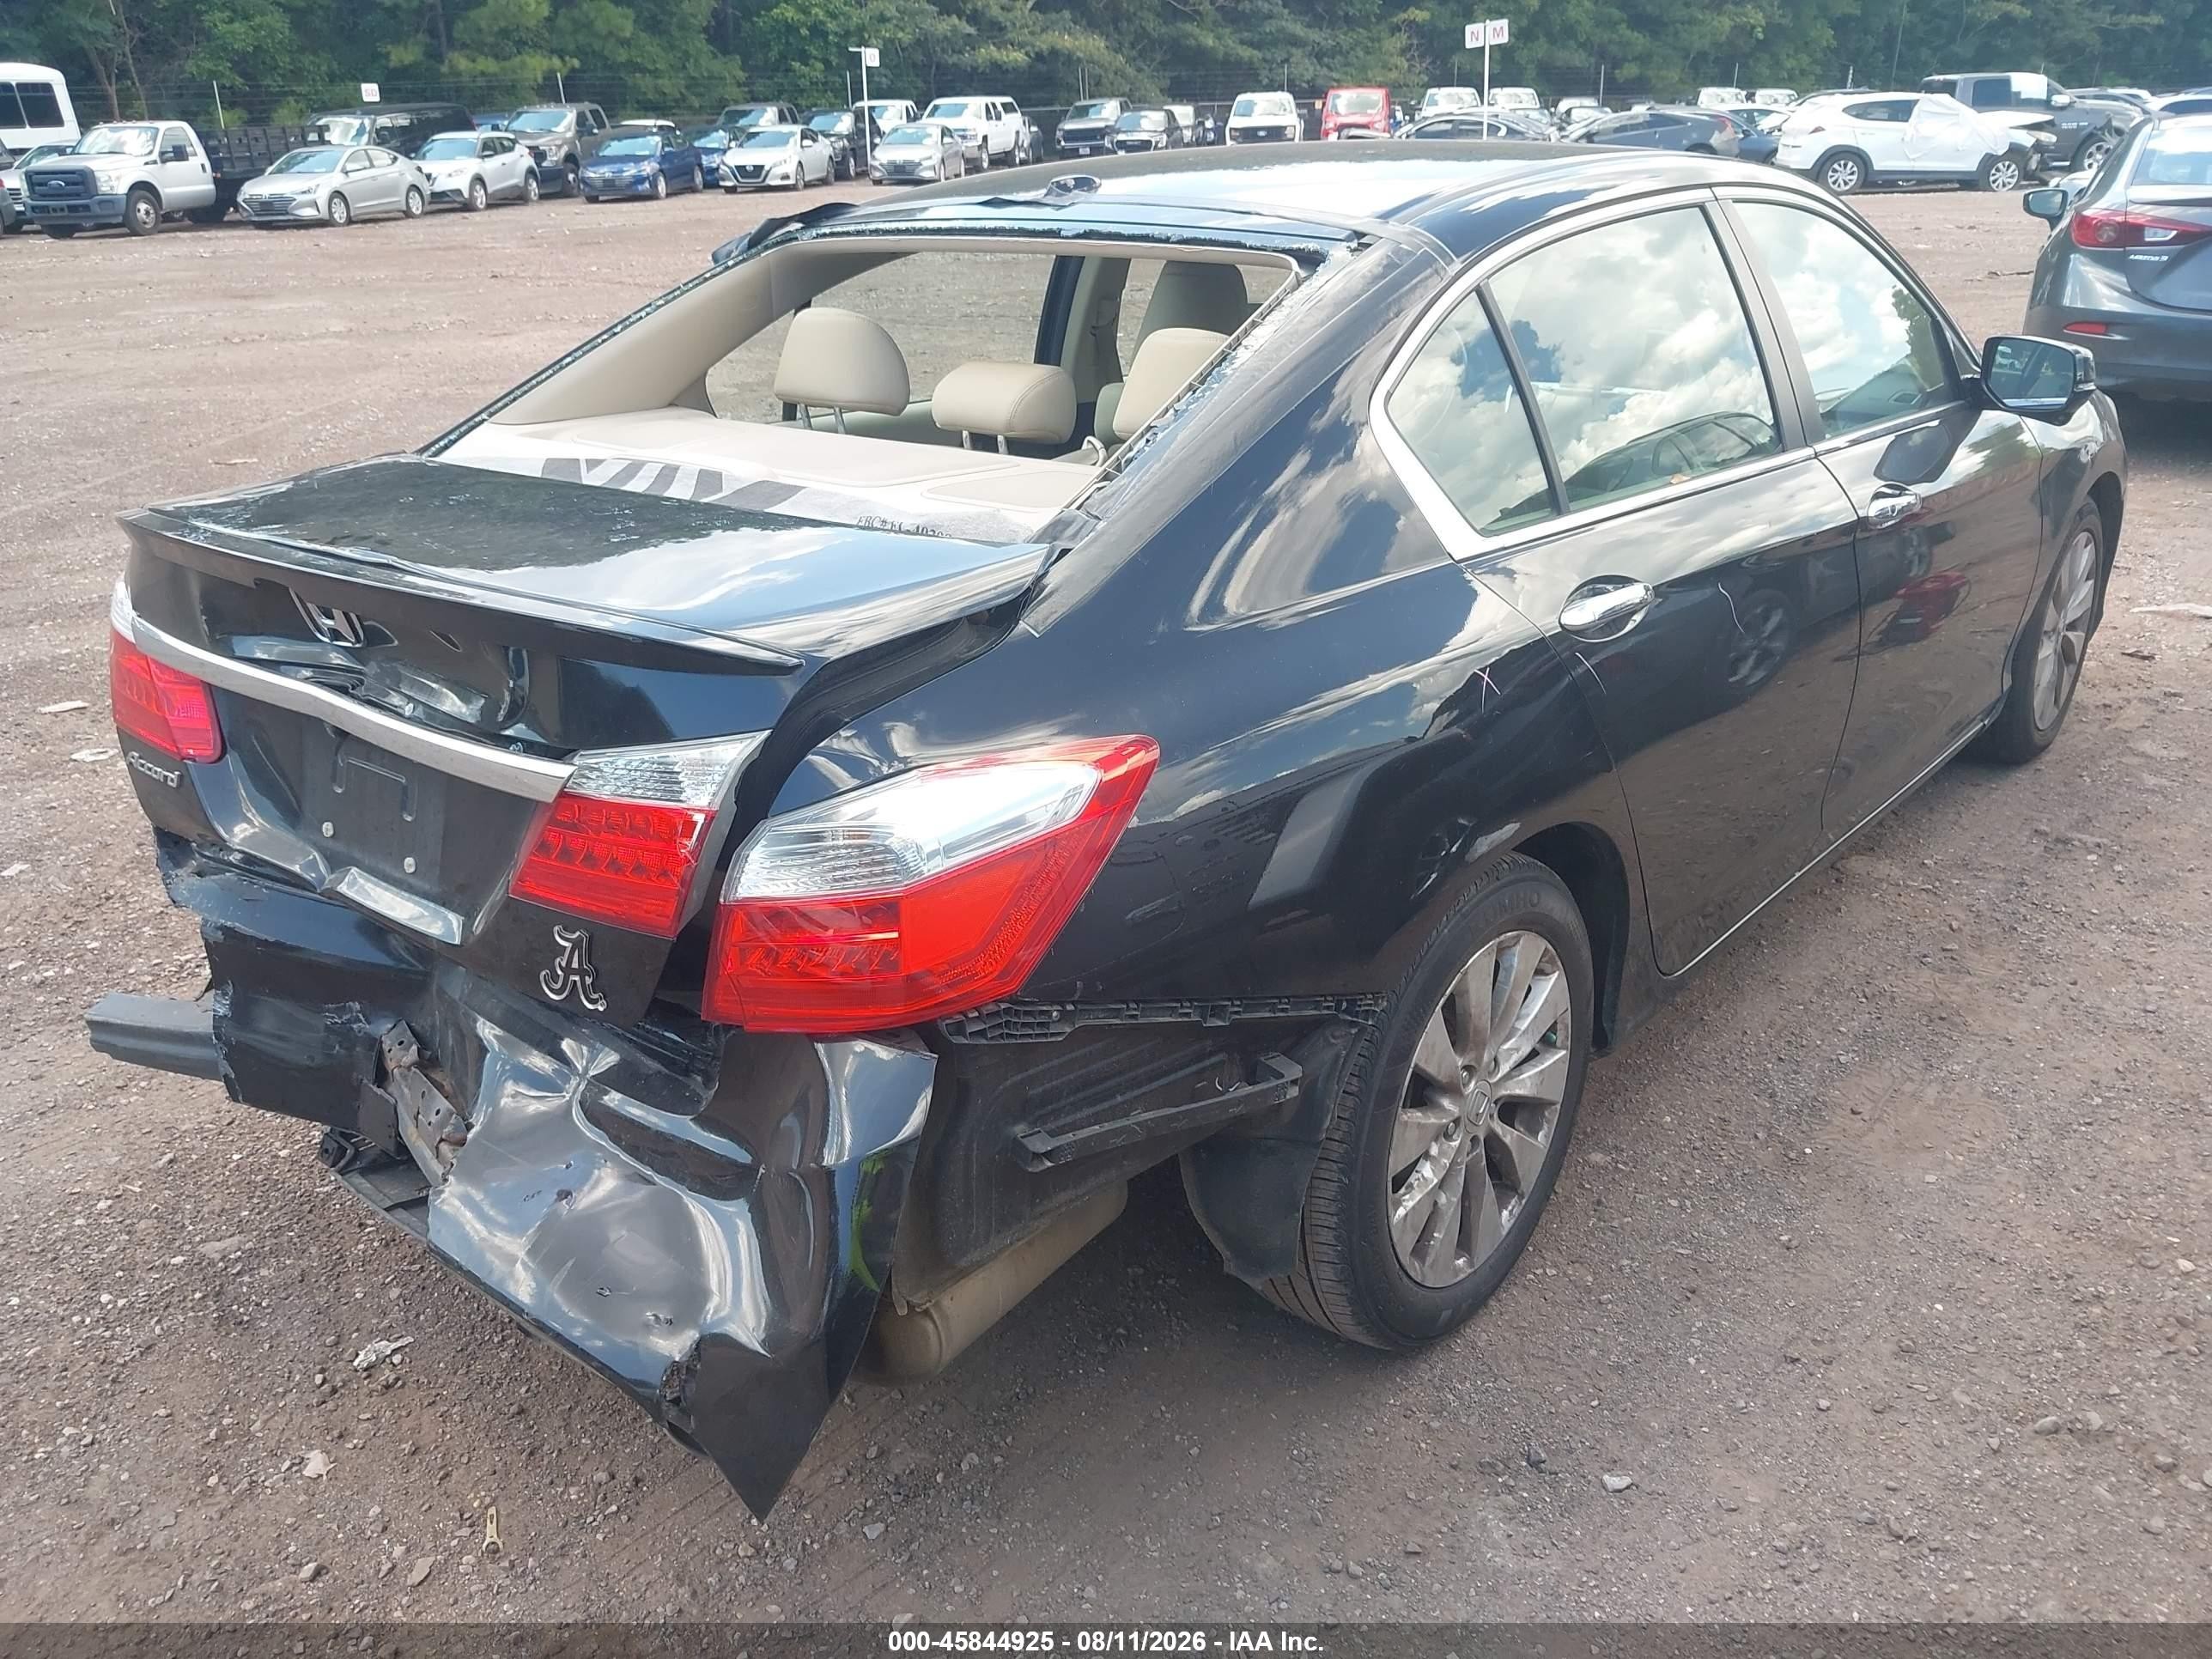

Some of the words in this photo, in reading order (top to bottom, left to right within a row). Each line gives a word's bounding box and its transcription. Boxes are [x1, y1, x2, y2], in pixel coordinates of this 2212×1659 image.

[1471, 29, 1480, 42] N
[1492, 26, 1504, 40] M
[126, 750, 181, 788] Accord
[539, 925, 608, 1012] A
